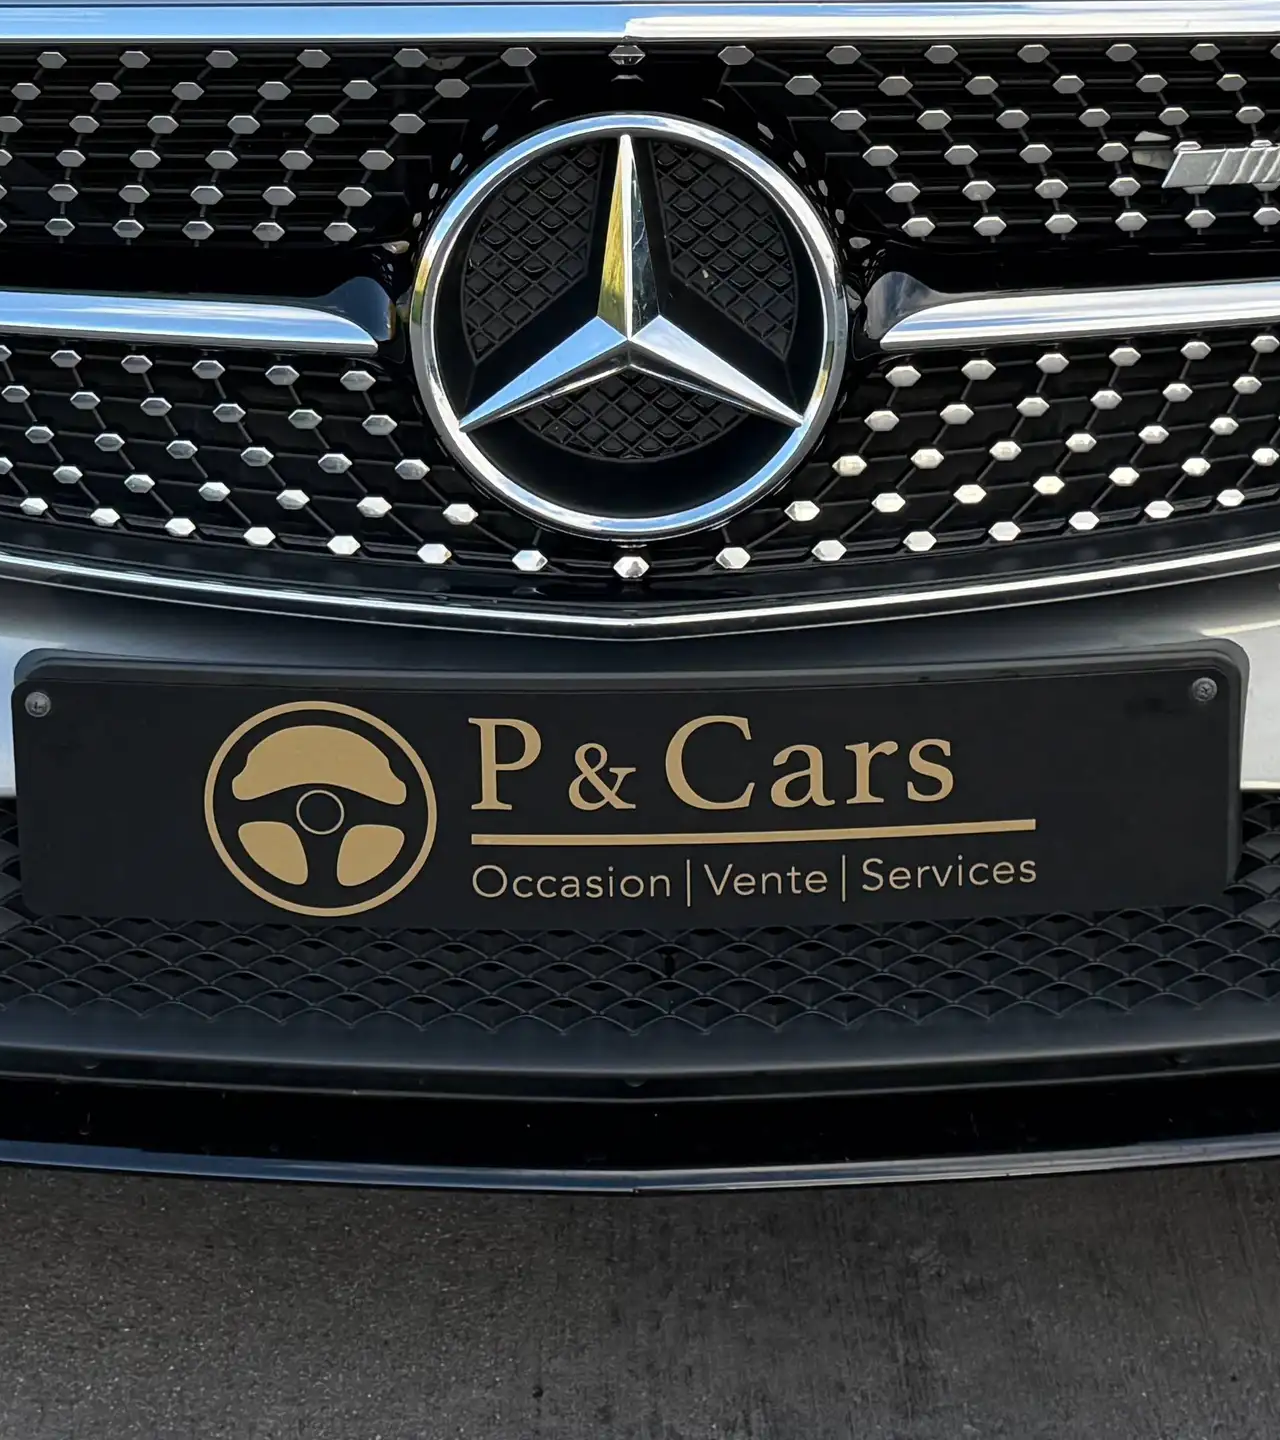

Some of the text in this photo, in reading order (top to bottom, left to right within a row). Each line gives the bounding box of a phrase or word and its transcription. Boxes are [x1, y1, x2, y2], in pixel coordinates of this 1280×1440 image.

[468, 714, 955, 811] P & Cars
[472, 864, 671, 899] Occasion
[703, 862, 829, 897] Vente
[861, 854, 1037, 892] Services
